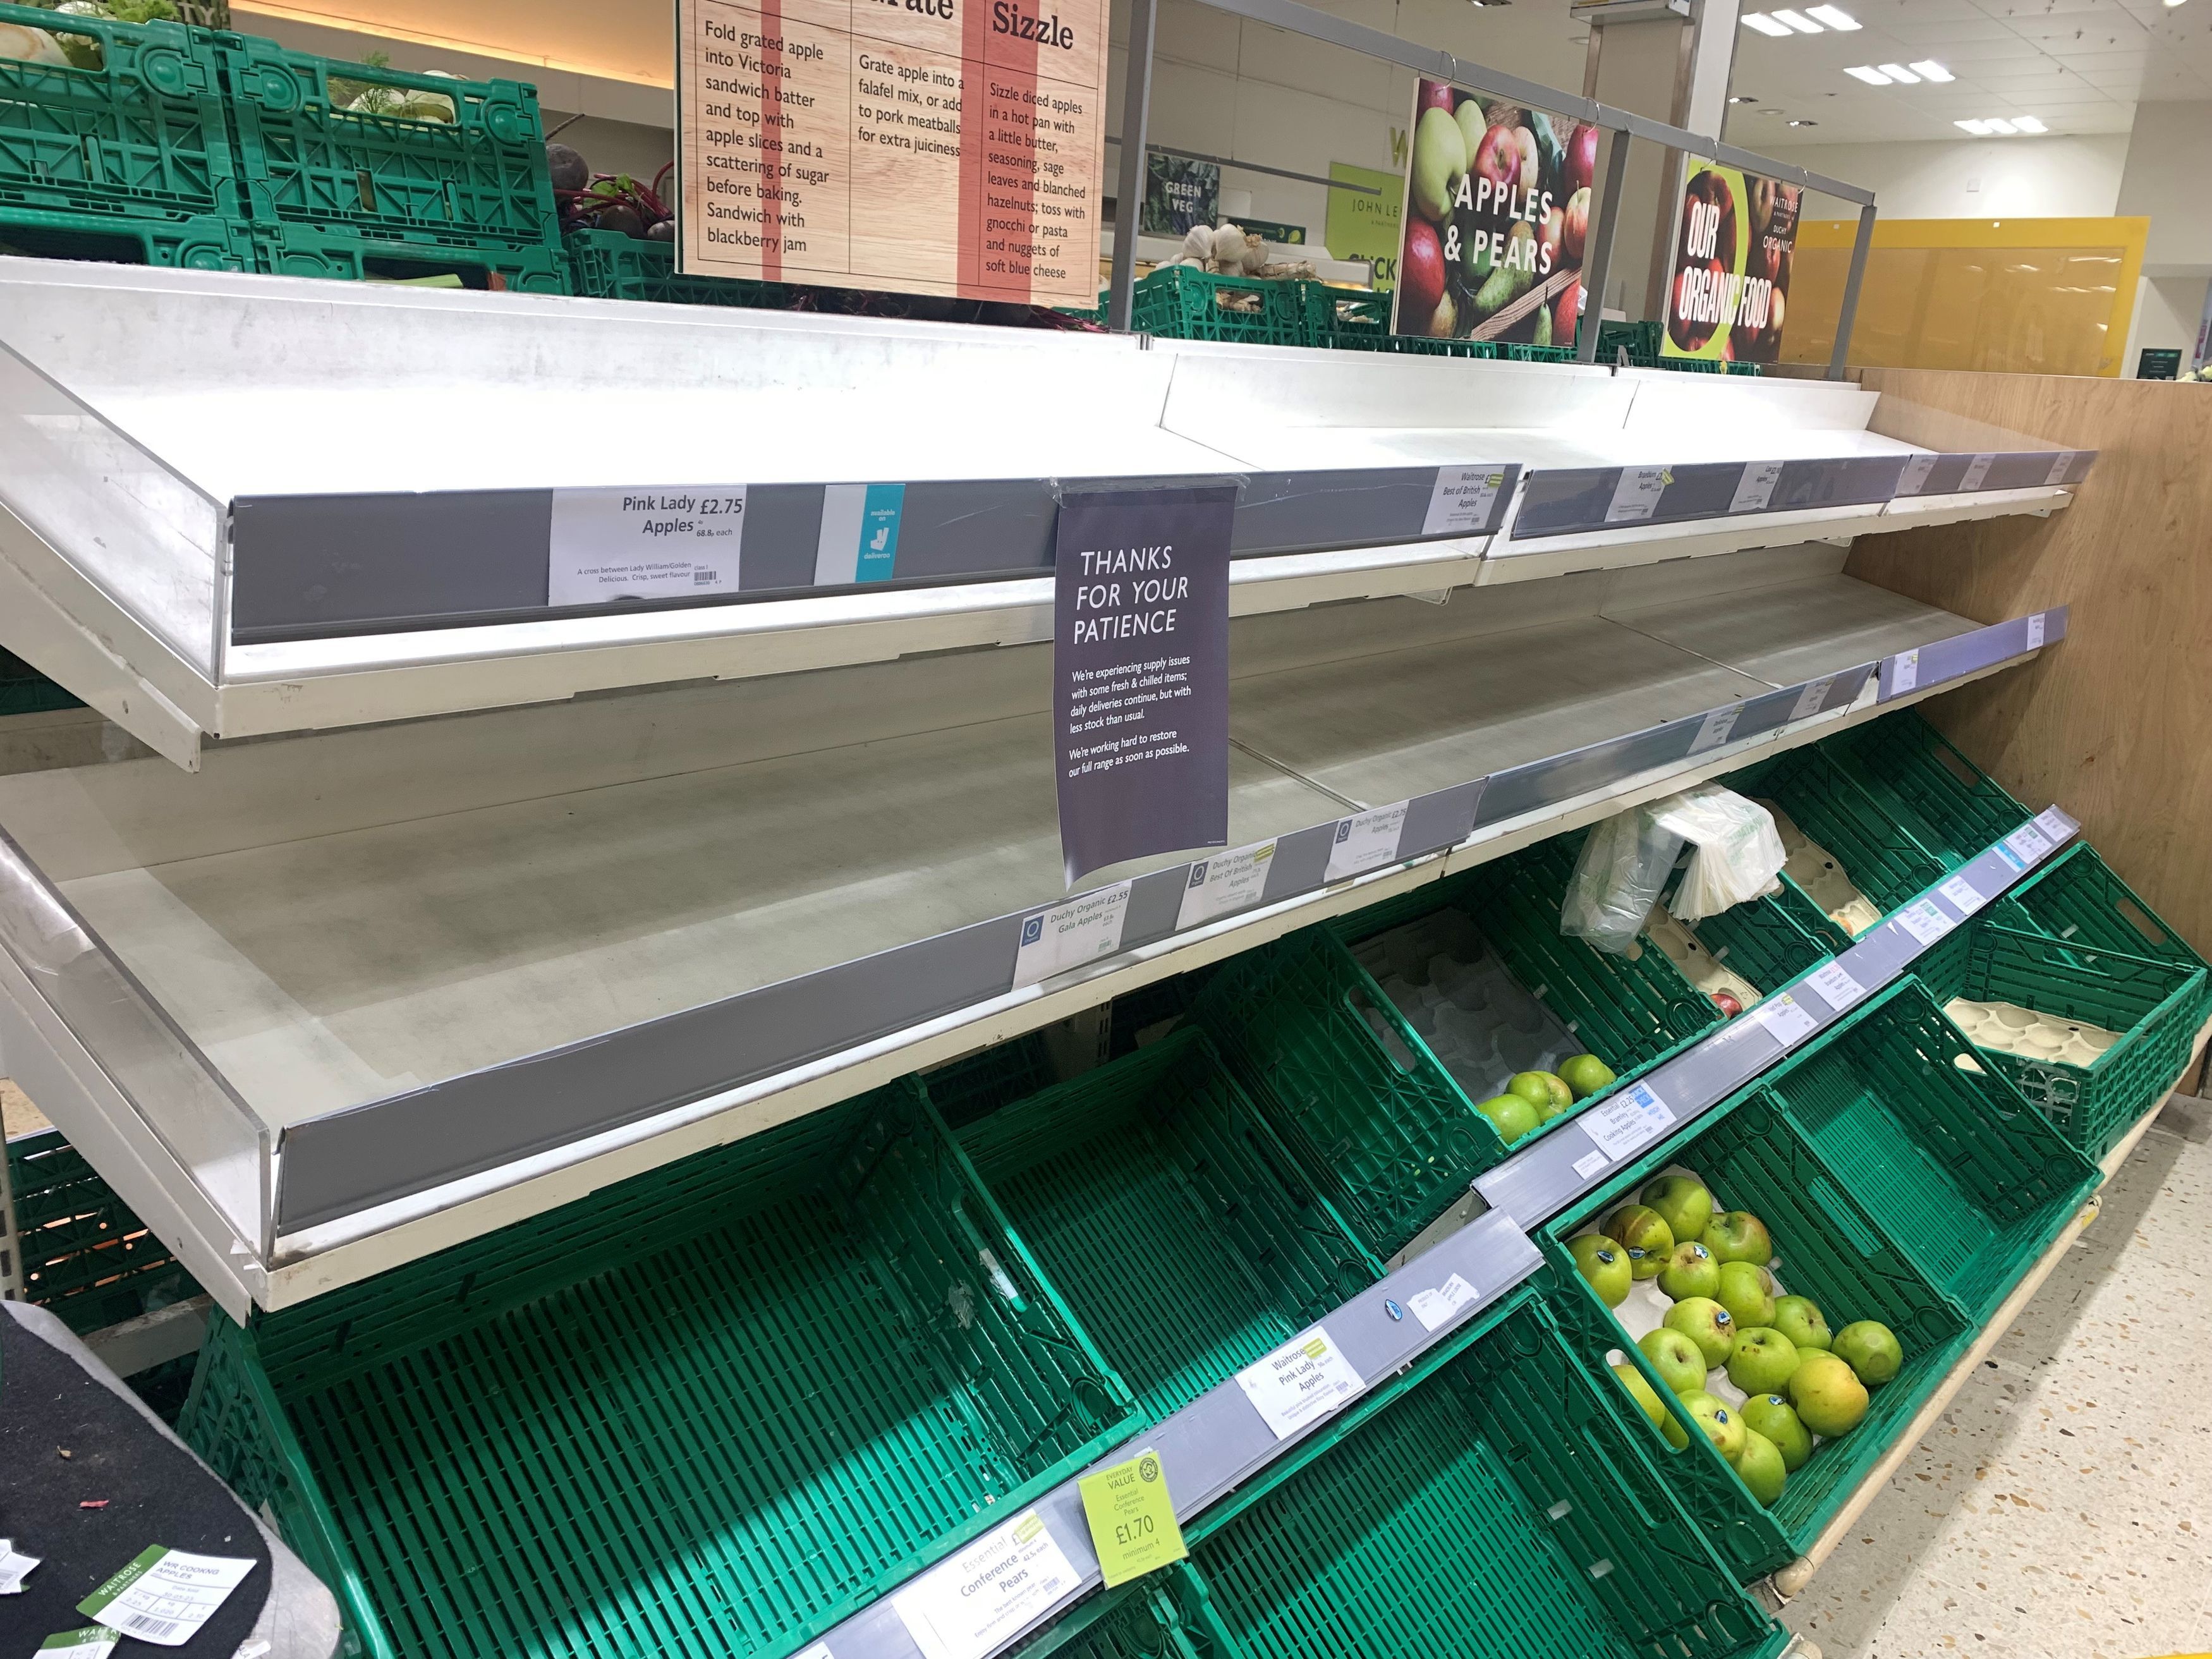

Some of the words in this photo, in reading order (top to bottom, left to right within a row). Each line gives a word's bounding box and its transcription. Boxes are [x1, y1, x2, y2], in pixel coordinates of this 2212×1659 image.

[993, 1, 1073, 50] Sizzle
[705, 20, 735, 41] Fold
[741, 33, 784, 51] grated
[789, 44, 823, 61] apple
[705, 47, 733, 67] into
[738, 53, 791, 78] Victoria
[860, 54, 894, 75] Grate
[898, 67, 928, 83] apple
[933, 70, 954, 87] into
[958, 79, 964, 90] a
[705, 78, 769, 99] sandwich
[775, 86, 815, 107] batter
[859, 78, 893, 99] falafel
[898, 89, 922, 106] mix,
[927, 96, 939, 107] or
[942, 97, 962, 112] add
[706, 103, 731, 118] and
[736, 107, 760, 127] top
[765, 112, 794, 128] with
[858, 104, 872, 118] to
[876, 109, 904, 124] pork
[908, 115, 961, 134] meatballs
[706, 129, 743, 147] apple
[748, 133, 783, 152] slices
[788, 142, 811, 156] and
[816, 147, 823, 158] a
[858, 126, 875, 142] for
[880, 134, 911, 149] extra
[914, 137, 961, 157] juiciness
[707, 155, 774, 179] scattering
[779, 164, 792, 177] of
[796, 168, 829, 185] sugar
[707, 176, 751, 197] before
[757, 183, 802, 207] baking.
[1165, 181, 1201, 198] GREEN
[1454, 174, 1553, 225] APPLES
[707, 202, 771, 223] Sandwich
[776, 213, 805, 228] with
[1172, 197, 1194, 214] VEG
[1352, 198, 1382, 215] JOHN
[1770, 195, 1799, 212] WAITROSE
[708, 227, 779, 253] blackberry
[783, 236, 806, 253] jam
[1687, 201, 1720, 260] OUR
[1773, 225, 1787, 234] DUCHY
[1445, 226, 1462, 262] &
[1473, 229, 1552, 274] PEARS
[1763, 235, 1792, 253] ORGANIC
[1679, 265, 1740, 324] ORGANIC
[1737, 276, 1772, 329] FOOD
[1461, 472, 1485, 482] Waitrose
[1443, 486, 1455, 495] Best
[1455, 485, 1464, 494] of
[1463, 485, 1481, 495] British
[623, 495, 655, 511] Pink
[660, 495, 696, 513] Lady
[700, 499, 743, 514] £2.75
[1458, 499, 1478, 509] Apples
[642, 518, 694, 536] Apples
[645, 562, 691, 571] William/Golden
[1080, 545, 1172, 576] THANKS
[1076, 583, 1121, 611] FOR
[1133, 576, 1188, 605] YOUR
[1074, 609, 1177, 645] PATIENCE
[1072, 669, 1094, 682] We're
[1095, 662, 1142, 679] experiencing
[1143, 657, 1167, 672] supply
[1169, 655, 1190, 667] issues
[1071, 688, 1088, 700] with
[1090, 686, 1110, 696] some
[1111, 681, 1129, 692] fresh
[1131, 678, 1138, 688] &
[1139, 673, 1163, 687] chilled
[1164, 672, 1188, 683] items;
[1071, 704, 1087, 717] daily
[1088, 698, 1122, 713] deliveries
[1124, 693, 1158, 706] continue,
[1160, 689, 1172, 700] but
[1174, 685, 1191, 696] with
[1070, 723, 1083, 734] less
[1085, 717, 1104, 731] stock
[1106, 714, 1122, 726] than
[1124, 708, 1145, 722] usual.
[1069, 747, 1089, 760] We're
[1090, 740, 1119, 753] working
[1121, 735, 1137, 748] hard
[1139, 734, 1148, 744] to
[1150, 730, 1177, 741] restore
[1069, 767, 1080, 777] our
[1081, 761, 1092, 773] full
[1094, 759, 1114, 770] range
[1115, 757, 1123, 765] as
[1125, 752, 1143, 763] soon
[1145, 750, 1153, 758] as
[1155, 742, 1190, 760] possible.
[1356, 817, 1372, 827] Duchy
[1372, 812, 1392, 823] Organic
[1392, 808, 1407, 819] £2.75
[1371, 823, 1389, 834] Apples
[1210, 873, 1224, 883] Best
[1224, 869, 1232, 878] Of
[1233, 863, 1253, 875] British
[1212, 858, 1232, 870] Duchy
[1229, 877, 1249, 888] Apples
[1050, 909, 1075, 923] Duchy
[1077, 897, 1105, 913] Organic
[1107, 890, 1129, 905] £2.55
[1059, 921, 1076, 933] Gala
[1077, 912, 1102, 927] Apples
[1600, 1102, 1620, 1117] Essential
[1620, 1095, 1634, 1109] £2.25
[1610, 1111, 1629, 1125] Bramley
[1603, 1127, 1624, 1141] Cooking
[1620, 1119, 1637, 1134] Apples
[1272, 1347, 1306, 1371] Waitrose
[1279, 1370, 1297, 1386] Pink
[1295, 1359, 1315, 1376] Lady
[1298, 1371, 1325, 1392] Apples
[1106, 1466, 1133, 1481] EVERYDAY
[1107, 1474, 1136, 1490] VALUE
[1114, 1495, 1145, 1511] Conference
[1115, 1488, 1139, 1502] Essential
[1124, 1507, 1139, 1517] Pears
[1115, 1514, 1154, 1545] £1.70
[962, 1536, 1007, 1574] Essential
[1036, 1542, 1048, 1553] each
[1122, 1542, 1155, 1560] minimum
[1155, 1538, 1160, 1547] 4
[98, 1562, 142, 1596] WAITROSE
[155, 1567, 193, 1579] APPLES
[163, 1561, 179, 1569] WR
[179, 1565, 219, 1576] COOKNG
[961, 1555, 1019, 1597] Conference
[999, 1568, 1029, 1593] Pears
